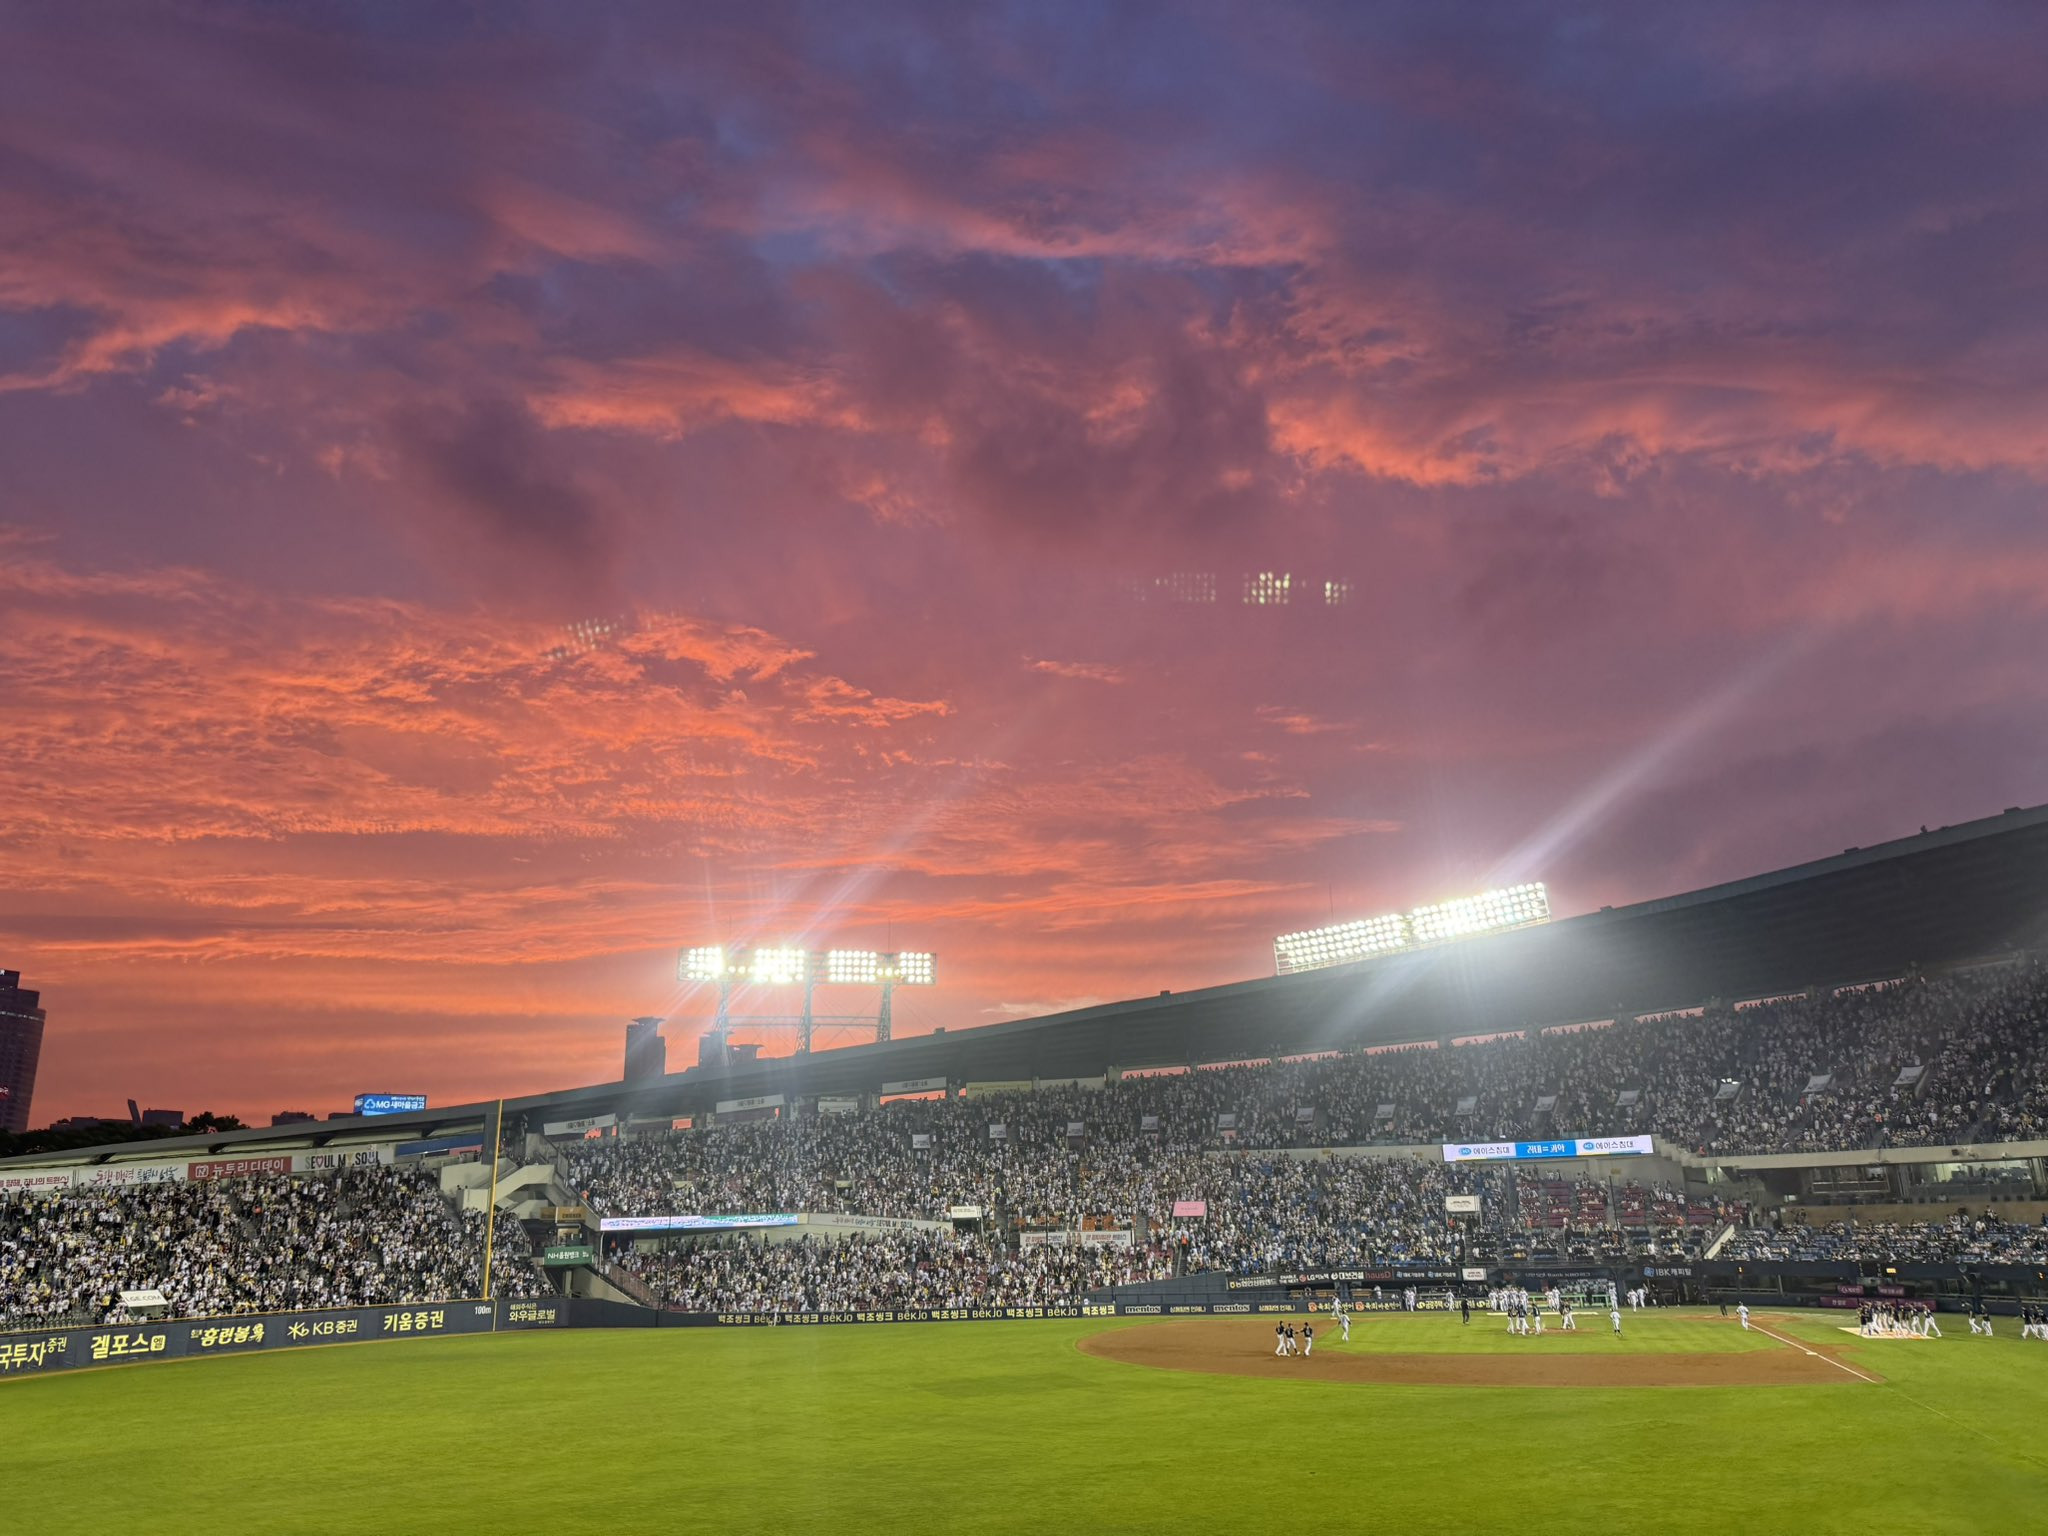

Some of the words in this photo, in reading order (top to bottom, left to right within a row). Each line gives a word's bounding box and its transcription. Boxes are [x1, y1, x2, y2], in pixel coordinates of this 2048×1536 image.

[391, 1101, 424, 1110] 새마을금고
[1596, 1140, 1634, 1150] 에이스침대
[1473, 1146, 1510, 1155] 에이스침대
[1656, 1268, 1692, 1276] IBK캐피탈
[475, 1306, 492, 1315] 100m
[1126, 1304, 1162, 1314] mentos
[1214, 1303, 1250, 1312] mentos
[509, 1309, 556, 1322] 와우글로벌
[718, 1314, 750, 1324] 백조씽크
[785, 1314, 818, 1323] 백조씽크
[856, 1312, 892, 1322] 백조씽크
[932, 1310, 968, 1319] 백조씽크
[1006, 1308, 1043, 1318] 백조씽크
[1082, 1305, 1115, 1316] 백조씽크
[384, 1310, 444, 1332] 키움증권
[312, 1320, 358, 1335] KB증권
